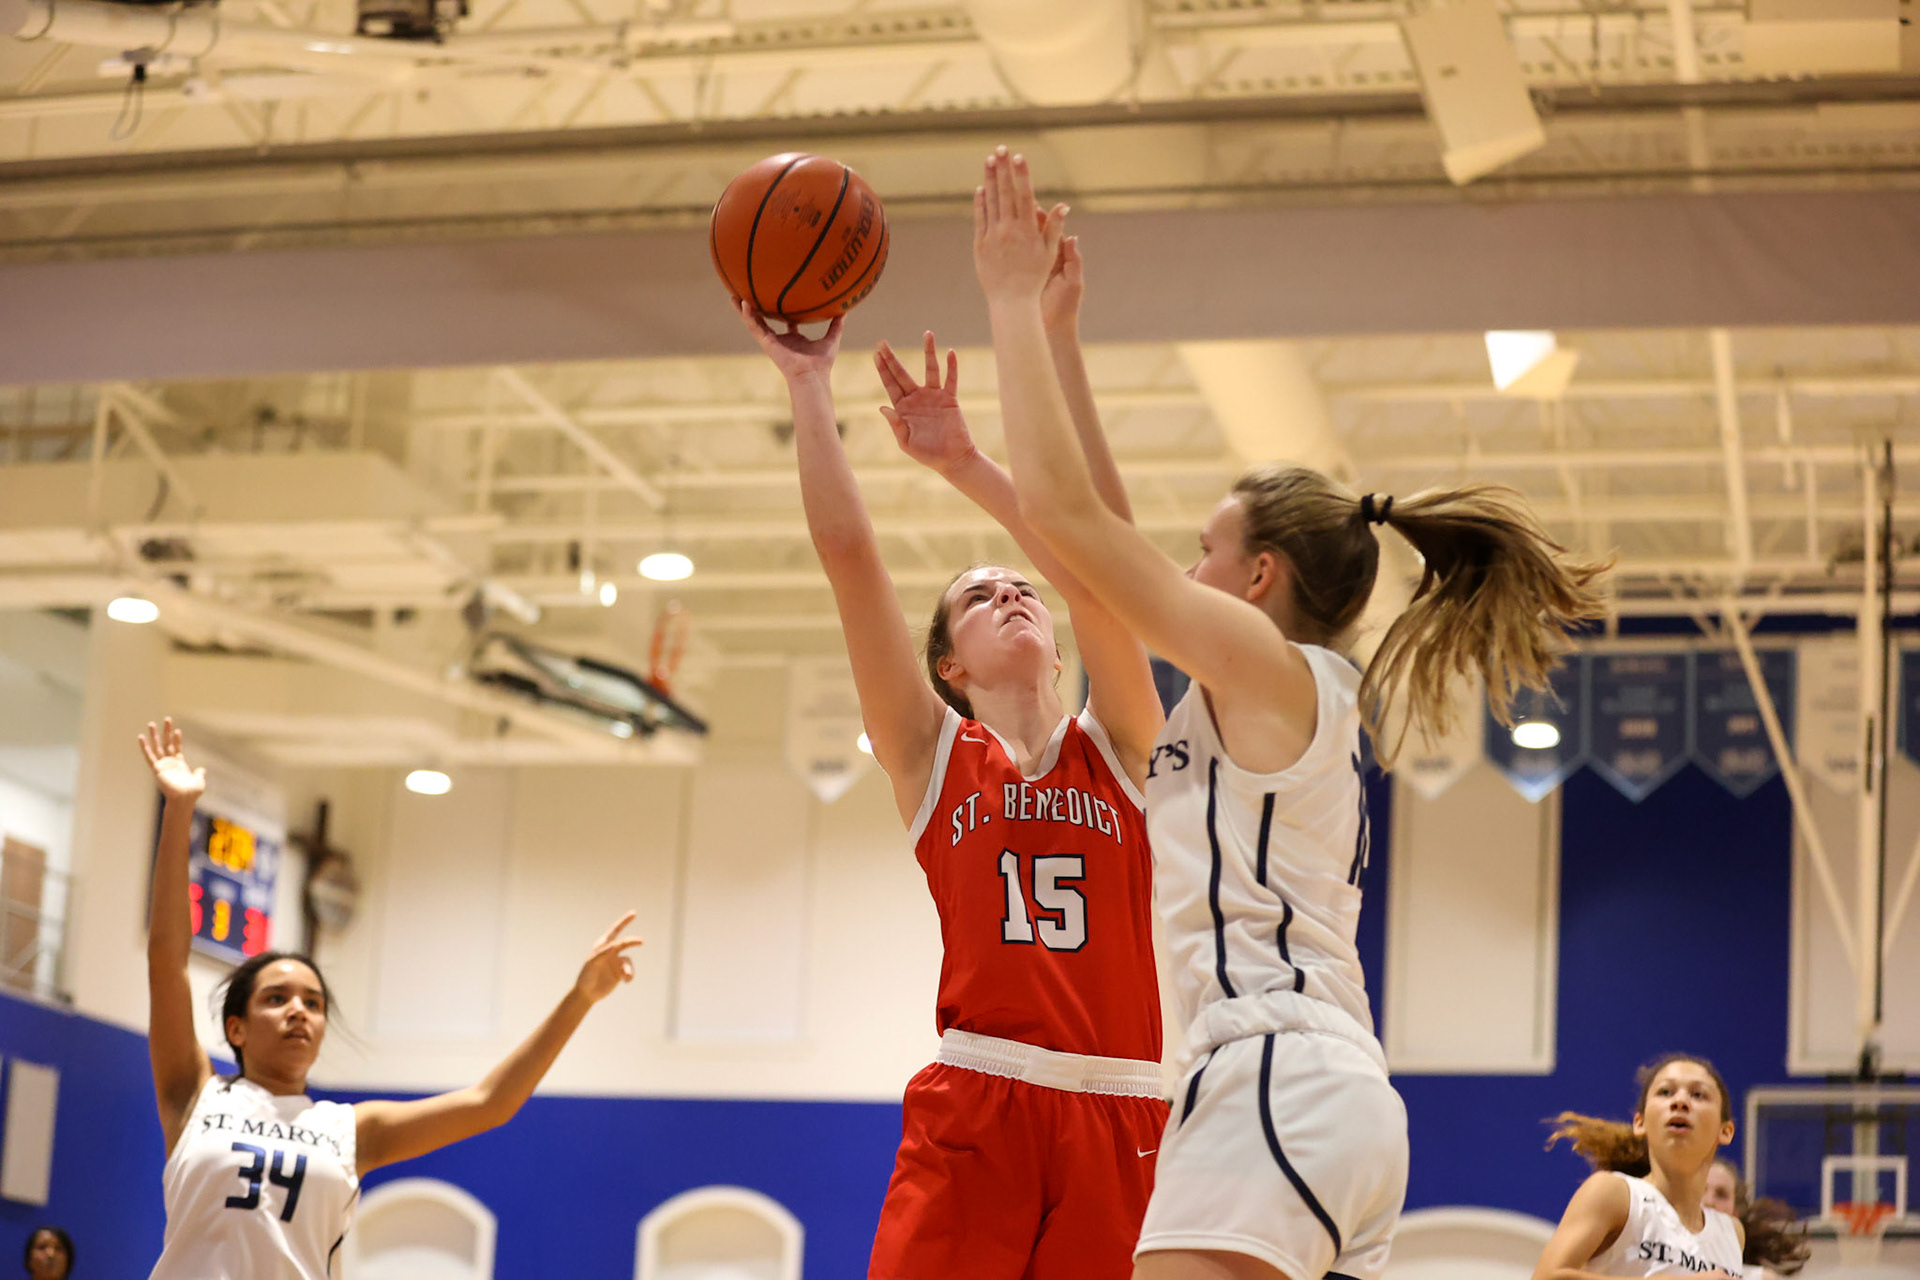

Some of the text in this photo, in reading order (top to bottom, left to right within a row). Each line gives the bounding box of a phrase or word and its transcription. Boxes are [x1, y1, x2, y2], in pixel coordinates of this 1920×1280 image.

[951, 782, 1123, 847] ST. BENEDICT
[997, 847, 1089, 953] 15
[201, 1112, 342, 1157] ST. MARY'S
[225, 1141, 308, 1223] 34
[1638, 1240, 1674, 1264] ST.
